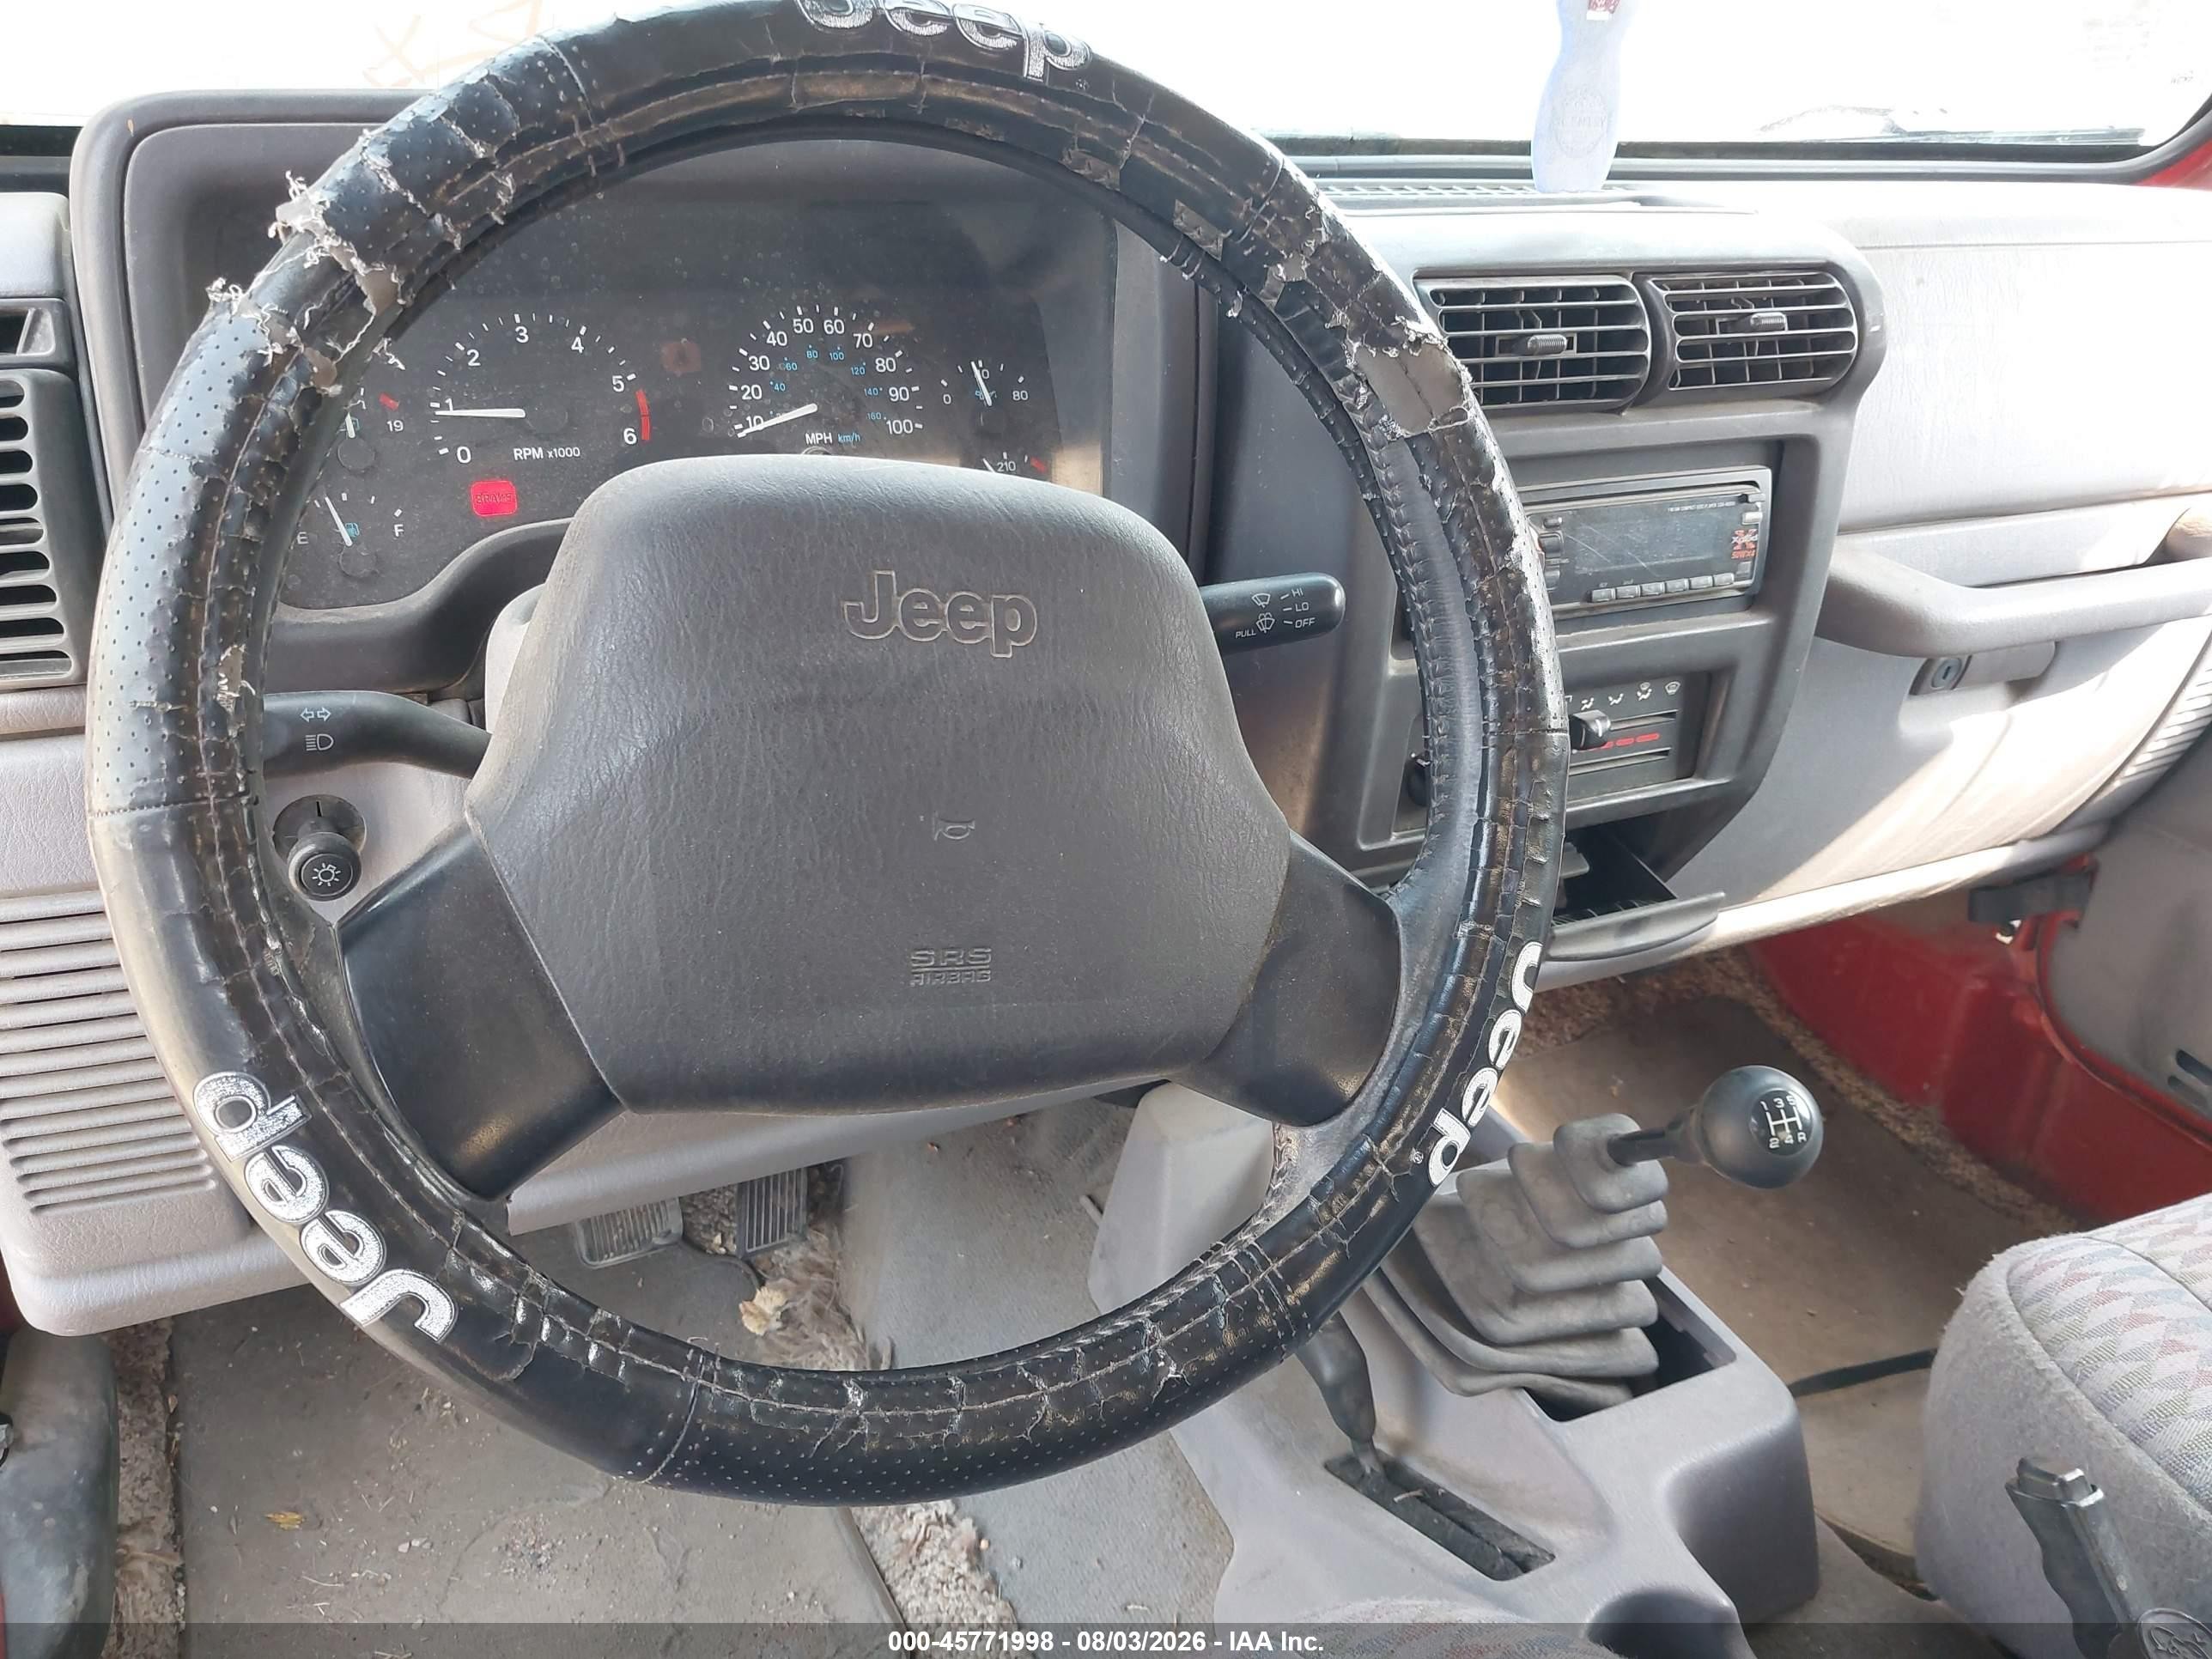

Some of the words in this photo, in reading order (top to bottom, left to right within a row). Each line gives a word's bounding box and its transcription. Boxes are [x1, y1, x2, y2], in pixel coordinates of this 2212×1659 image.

[793, 318, 814, 333] 50
[823, 319, 845, 334] 60
[515, 325, 529, 343] 3
[766, 331, 787, 346] 40
[853, 332, 873, 349] 70
[571, 336, 585, 353] 4
[466, 349, 481, 367] 2
[806, 349, 818, 360] 80
[830, 352, 845, 361] 100
[748, 356, 770, 371] 30
[786, 362, 798, 371] 60
[851, 366, 866, 375] 120
[875, 357, 896, 373] 80
[611, 374, 625, 392] 5
[774, 383, 786, 392] 40
[741, 385, 763, 400] 20
[864, 387, 878, 396] 140
[888, 386, 909, 402] 90
[943, 393, 951, 404] 0
[1012, 390, 1029, 401] 80
[445, 398, 453, 411] 1
[746, 415, 764, 429] 10
[867, 411, 882, 421] 160
[386, 419, 404, 432] 19
[885, 419, 914, 434] 100
[623, 428, 637, 445] 6
[805, 432, 833, 445] MPH
[837, 433, 861, 444] km/h
[456, 446, 471, 464] 0
[513, 447, 544, 461] RPM
[547, 447, 580, 459] x1000
[996, 460, 1017, 472] 210
[296, 531, 309, 545] E
[394, 523, 404, 538] F
[1291, 587, 1304, 598] HI
[842, 569, 1038, 659] Jeep
[1295, 602, 1310, 612] LO
[1295, 617, 1316, 629] OFF
[1235, 629, 1257, 639] PULL
[910, 947, 992, 968] SRS
[909, 969, 992, 987] AIRBAG
[1427, 940, 1545, 1188] Jeep
[1760, 1101, 1769, 1111] 1
[1773, 1097, 1784, 1109] 3
[1786, 1095, 1797, 1106] 5
[1769, 1137, 1780, 1149] 2
[1784, 1133, 1794, 1145] 4
[1797, 1131, 1807, 1143] R
[192, 1071, 459, 1342] Jeep
